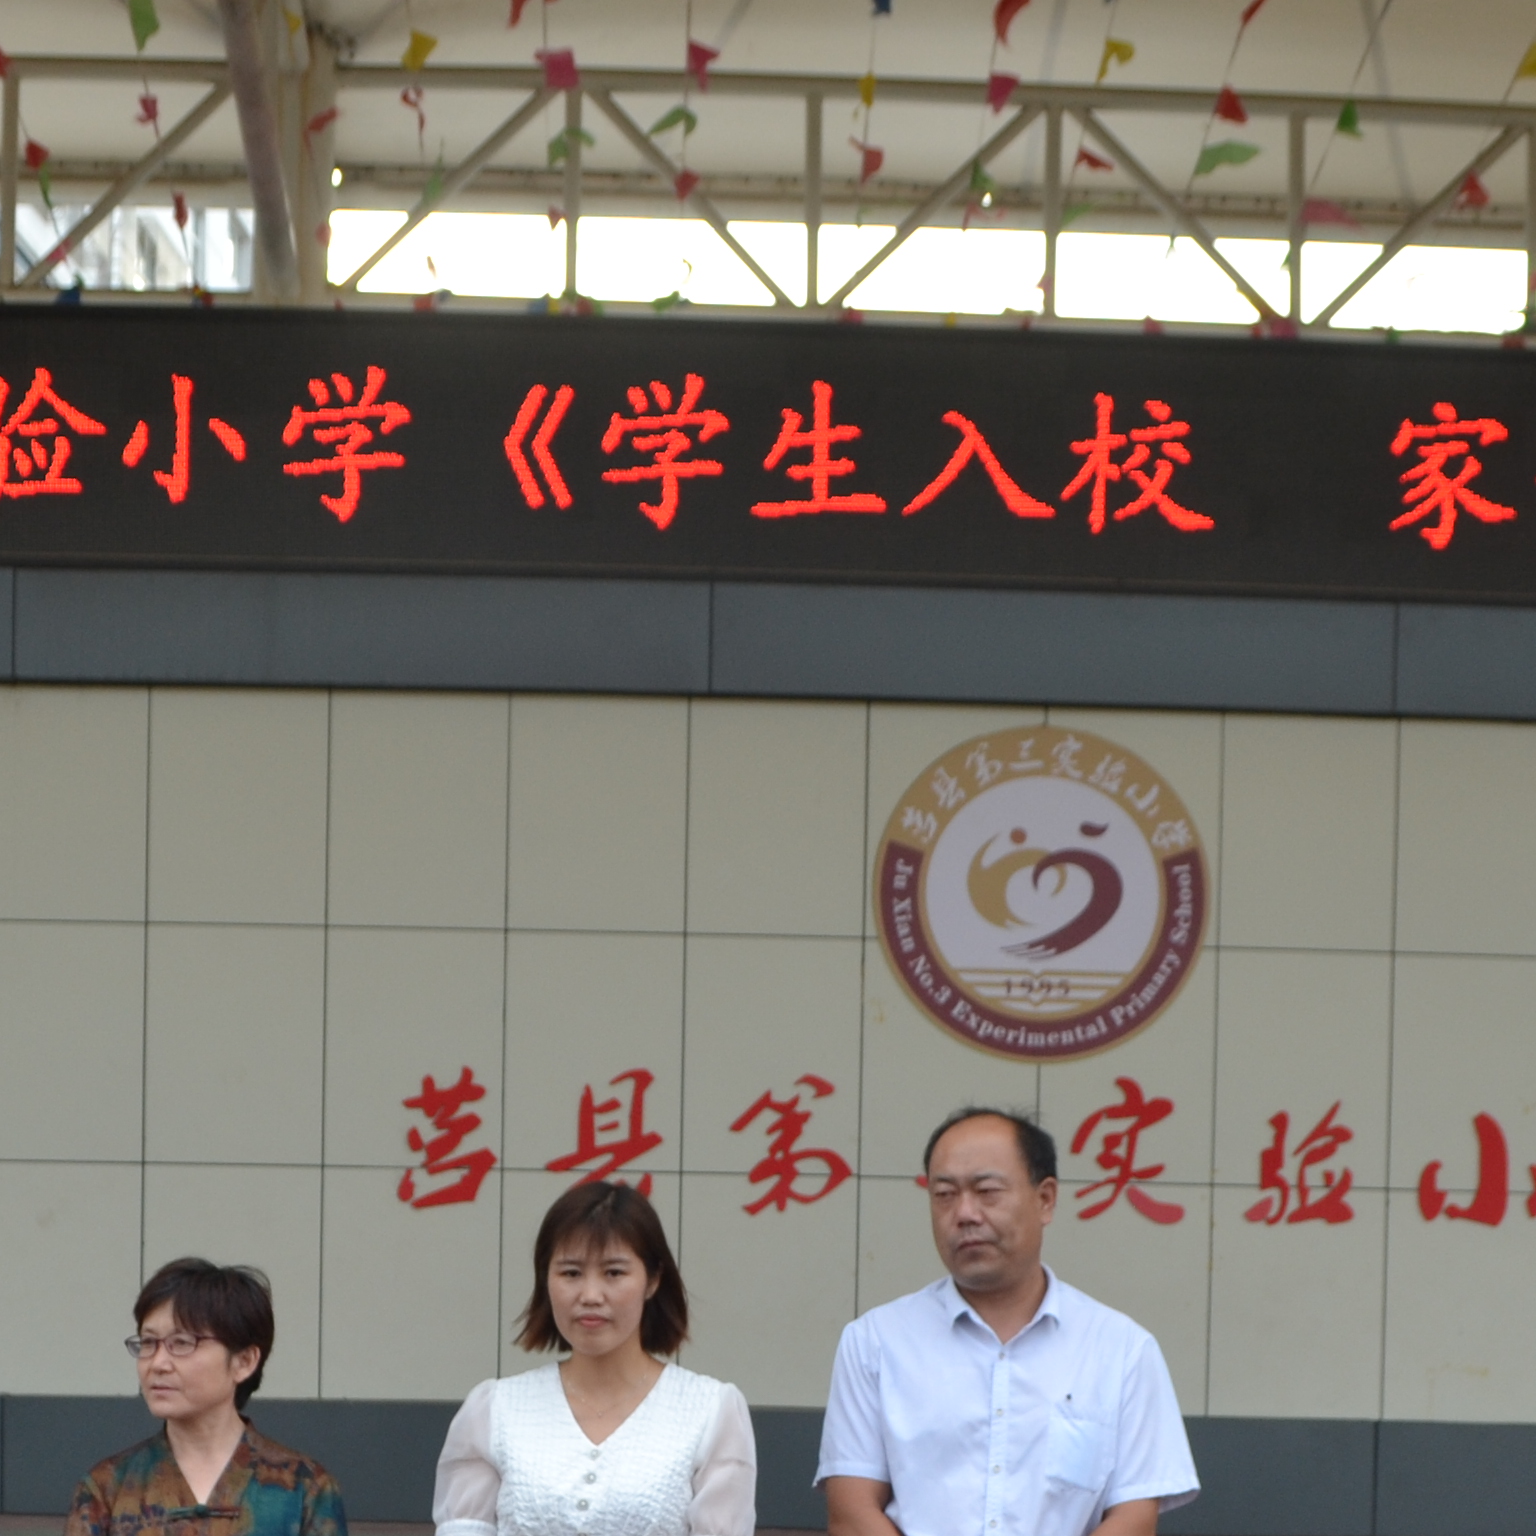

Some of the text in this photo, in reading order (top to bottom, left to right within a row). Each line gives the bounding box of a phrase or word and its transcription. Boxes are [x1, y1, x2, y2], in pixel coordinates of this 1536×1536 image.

[892, 896, 915, 954] Xian
[908, 954, 952, 1005] No.3
[950, 999, 1108, 1046] Experimental
[1109, 949, 1181, 1027] Primary
[1169, 862, 1193, 945] School
